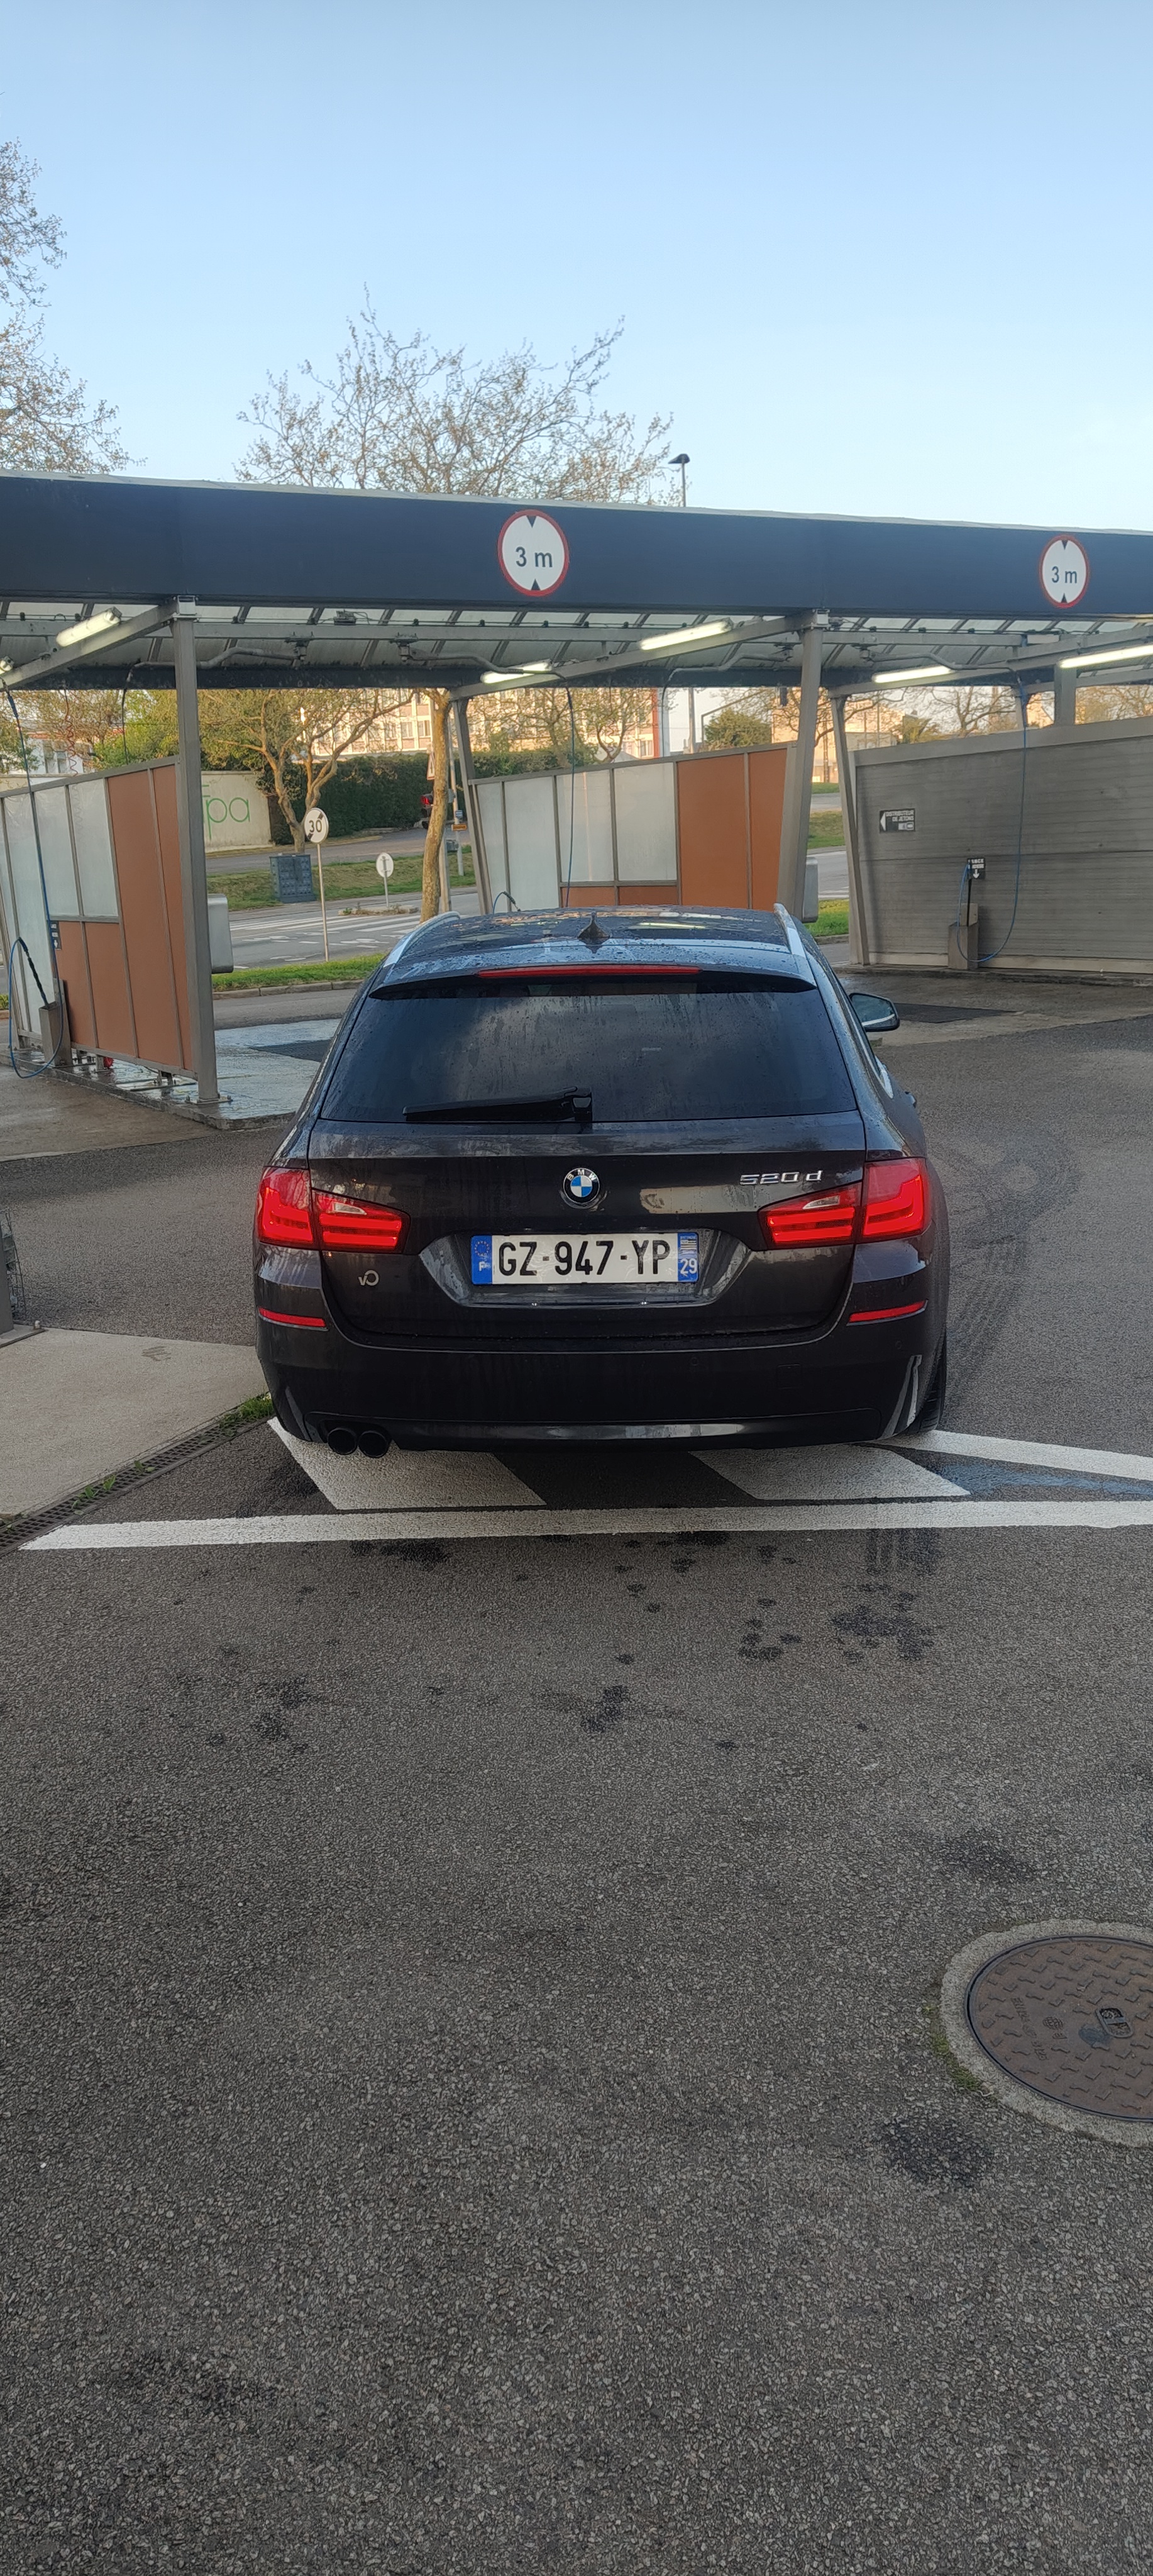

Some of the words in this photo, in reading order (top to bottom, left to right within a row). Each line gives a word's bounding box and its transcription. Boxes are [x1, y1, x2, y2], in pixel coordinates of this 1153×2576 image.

[516, 547, 527, 567] 3
[534, 552, 553, 567] m
[1051, 566, 1059, 583] 3
[1065, 570, 1077, 584] m
[309, 819, 323, 833] 30
[566, 1169, 597, 1181] BMW
[499, 1240, 671, 1276] GZ-947-YP
[680, 1258, 697, 1275] 29
